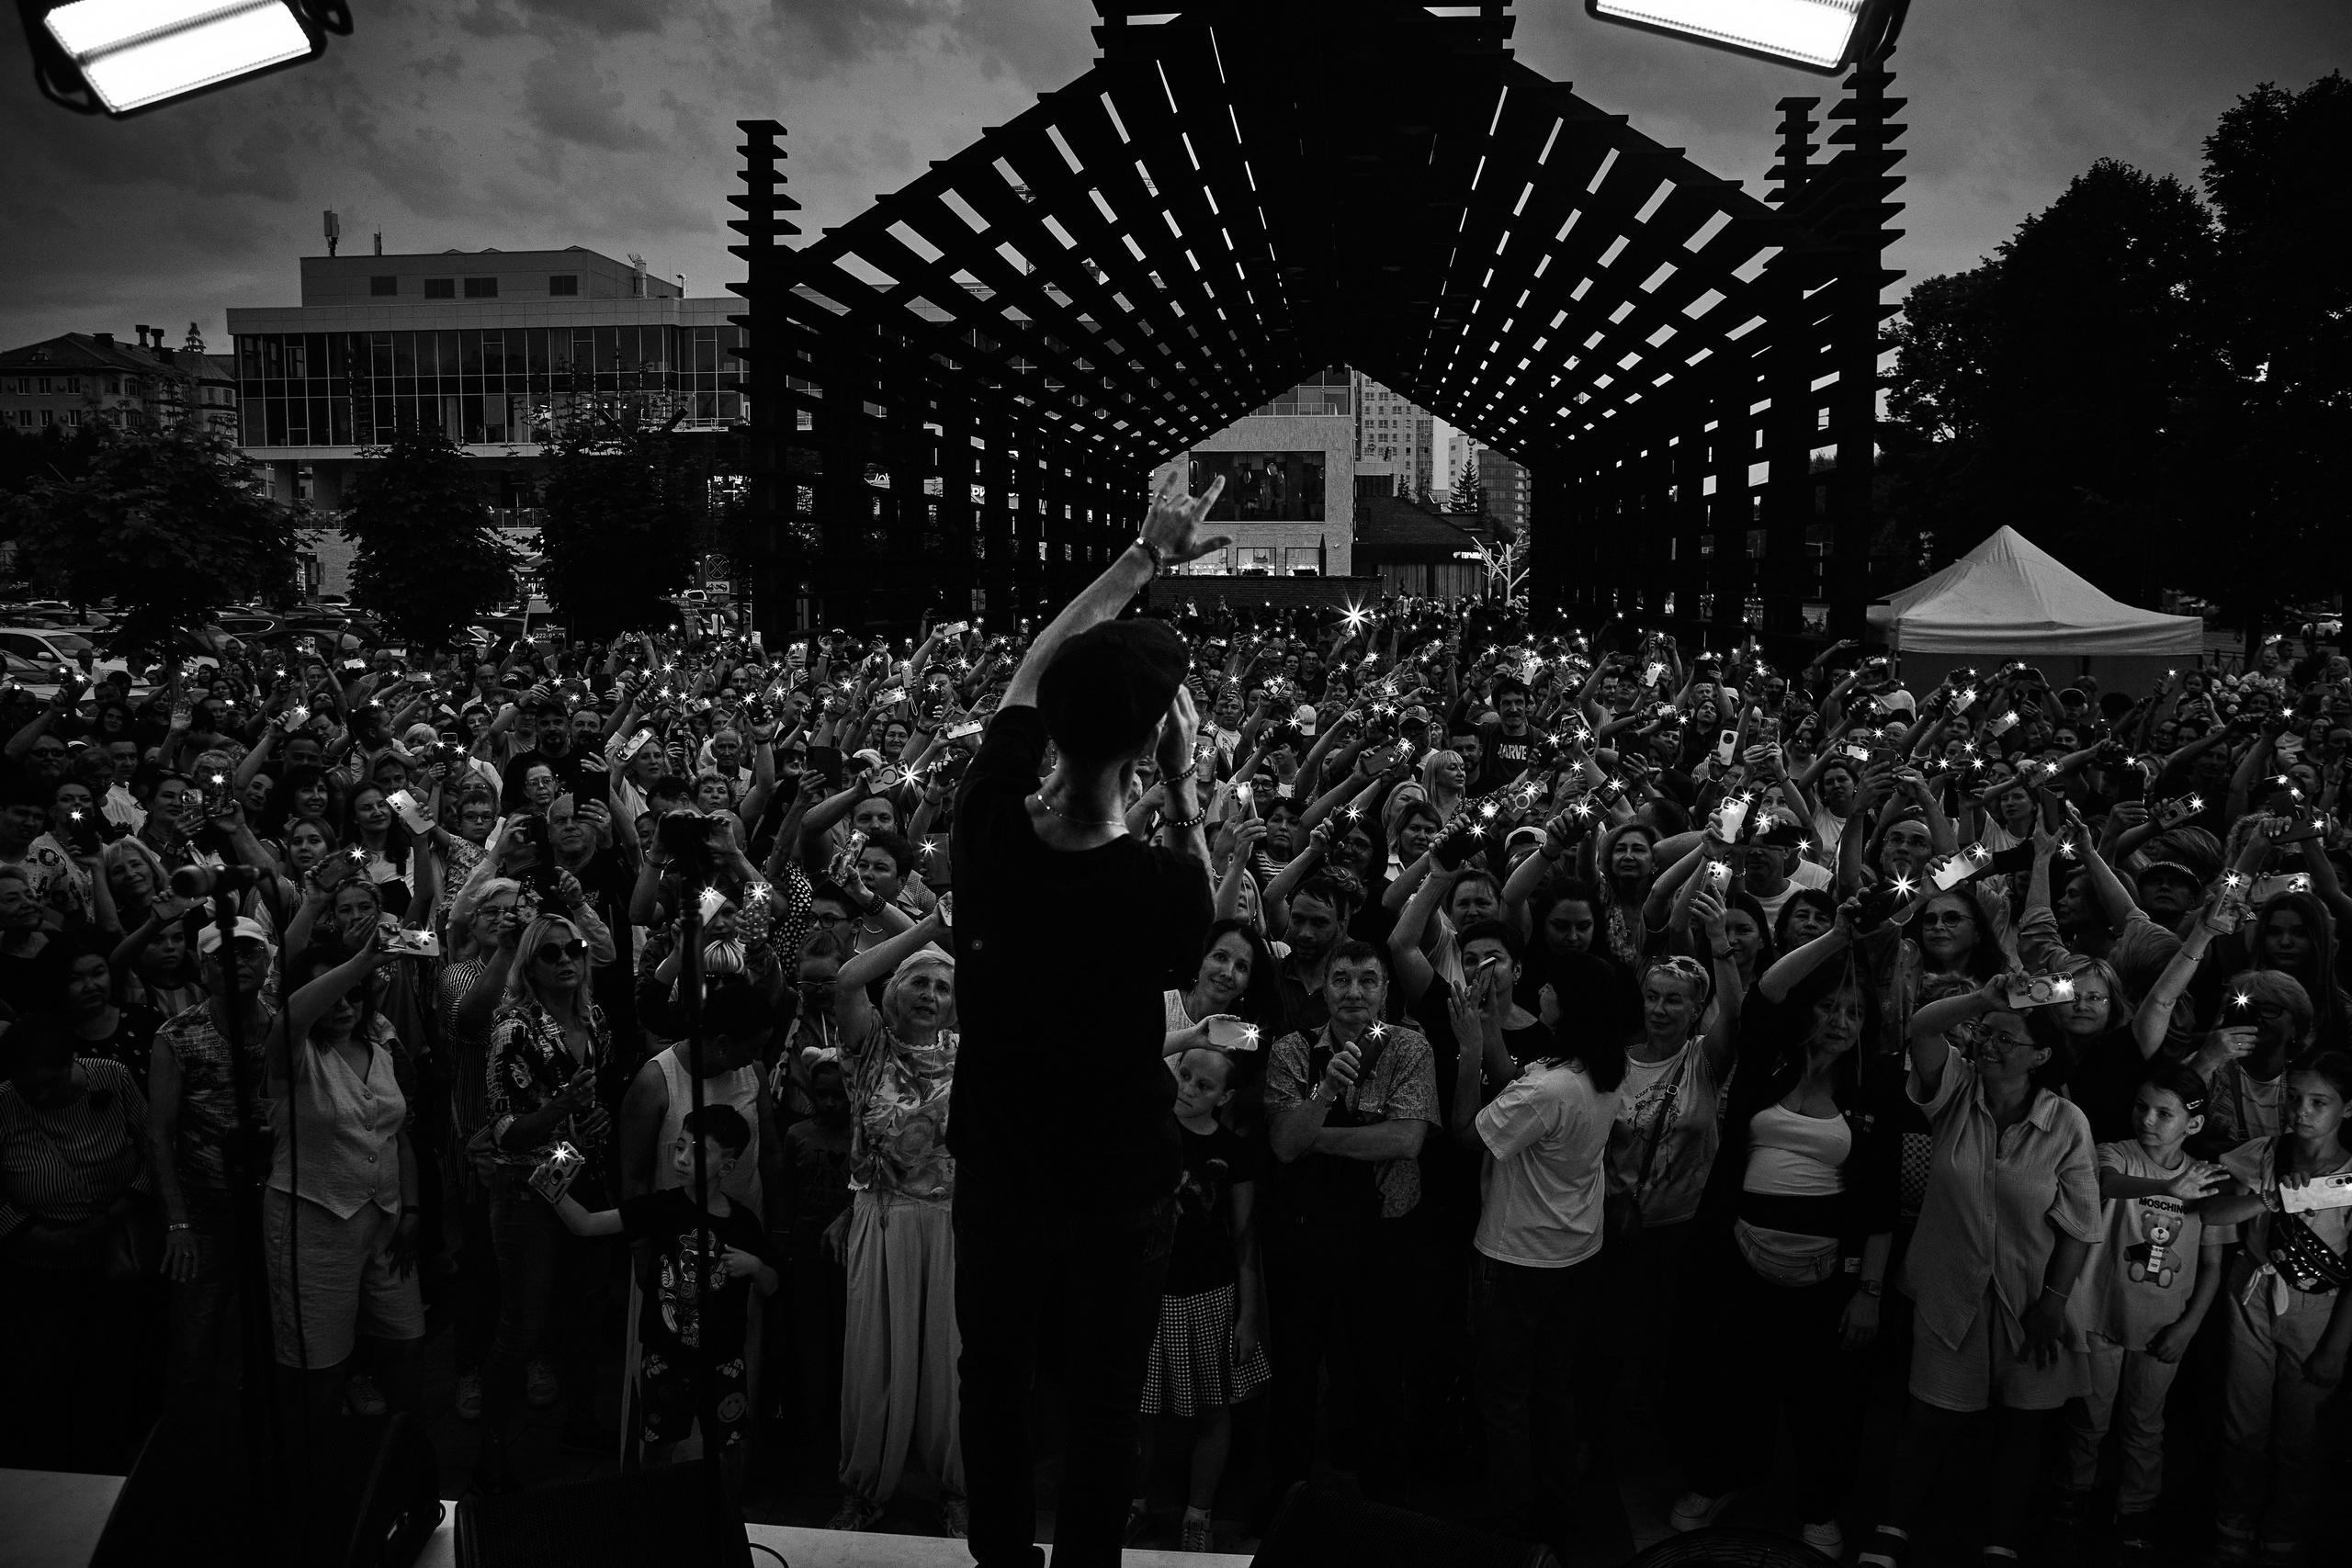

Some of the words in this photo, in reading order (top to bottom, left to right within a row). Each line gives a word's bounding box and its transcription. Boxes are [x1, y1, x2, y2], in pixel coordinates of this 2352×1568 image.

[1498, 743, 1527, 761] ARVE
[1634, 1088, 1649, 1100] KEEP
[2139, 1197, 2189, 1214] MOSCHINO
[682, 1336, 701, 1348] WORL
